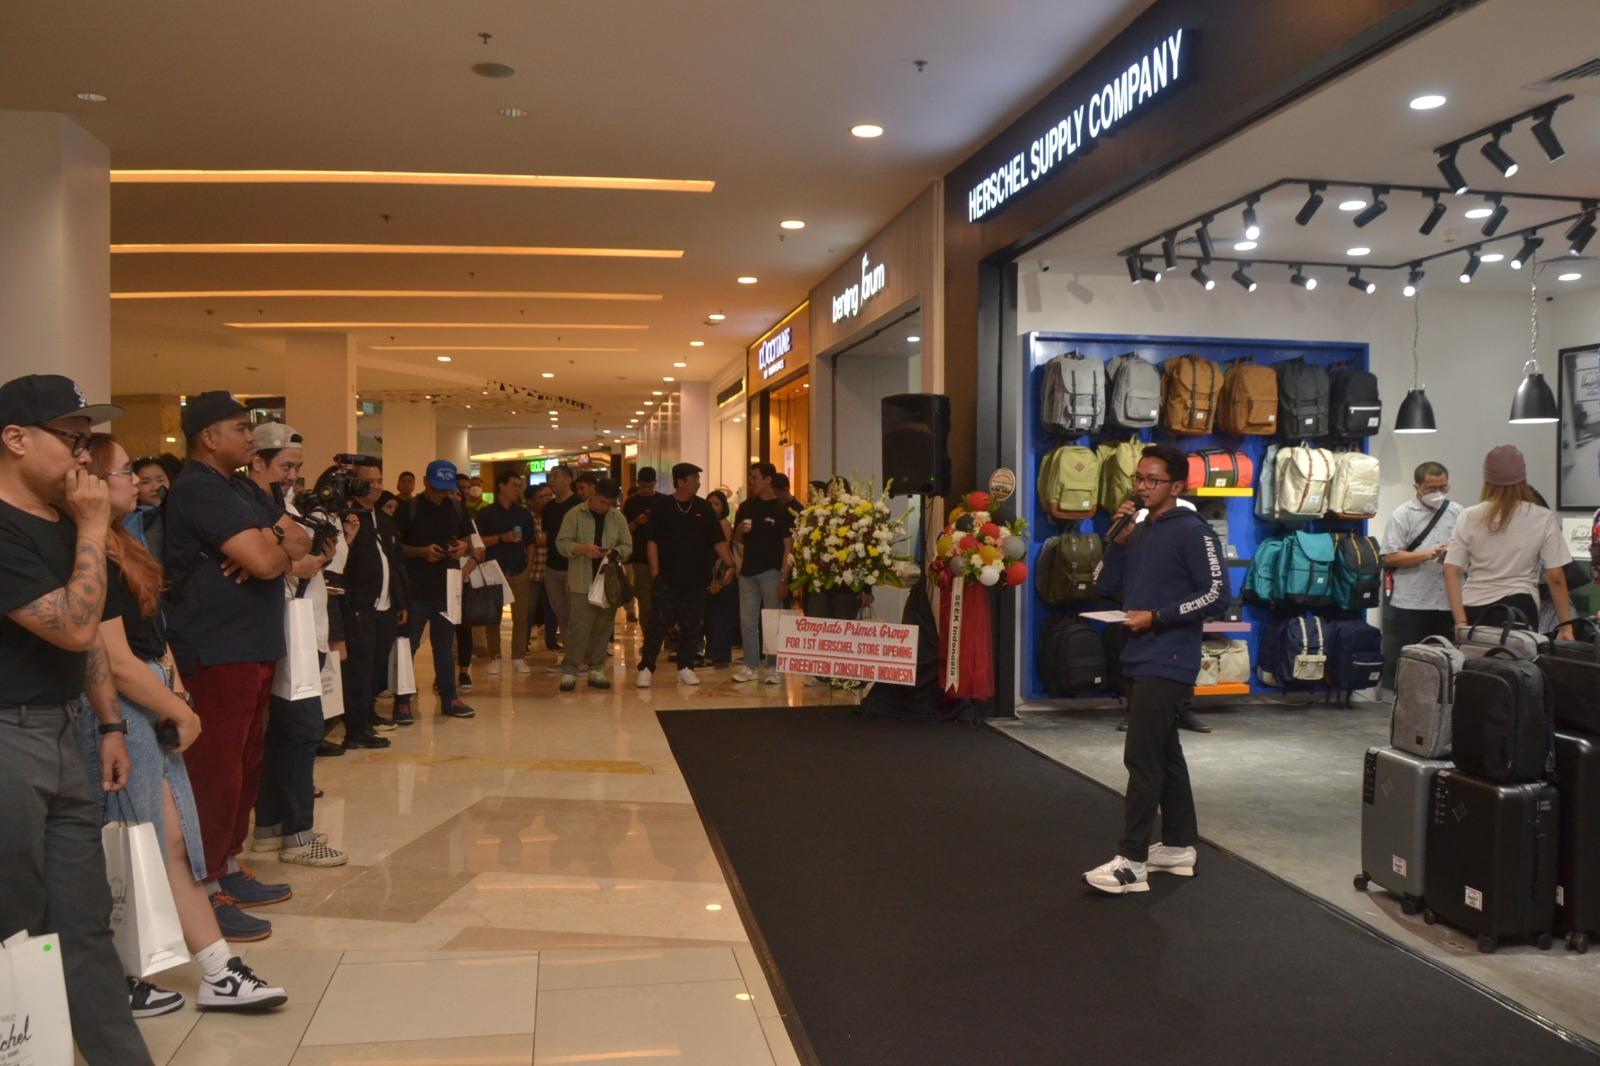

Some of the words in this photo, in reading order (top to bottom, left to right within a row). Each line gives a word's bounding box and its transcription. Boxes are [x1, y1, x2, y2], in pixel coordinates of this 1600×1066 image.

[968, 152, 1029, 223] HERSCHEL
[1030, 104, 1085, 180] SUPPLY
[1088, 28, 1183, 138] COMPANY
[1203, 535, 1222, 577] COMPANY
[953, 594, 961, 622] SEEK
[795, 618, 842, 637] Congrats
[844, 621, 878, 637] Primer
[880, 624, 910, 643] Group
[785, 636, 801, 649] FOR
[803, 638, 816, 649] 1ST
[818, 639, 854, 653] HERSCHEL
[858, 642, 880, 656] STORE
[883, 645, 913, 659] OPENING
[950, 626, 959, 676] Indonesia
[777, 657, 787, 670] PT
[834, 662, 875, 680] CONSULTING
[878, 666, 914, 684] INDONESIA
